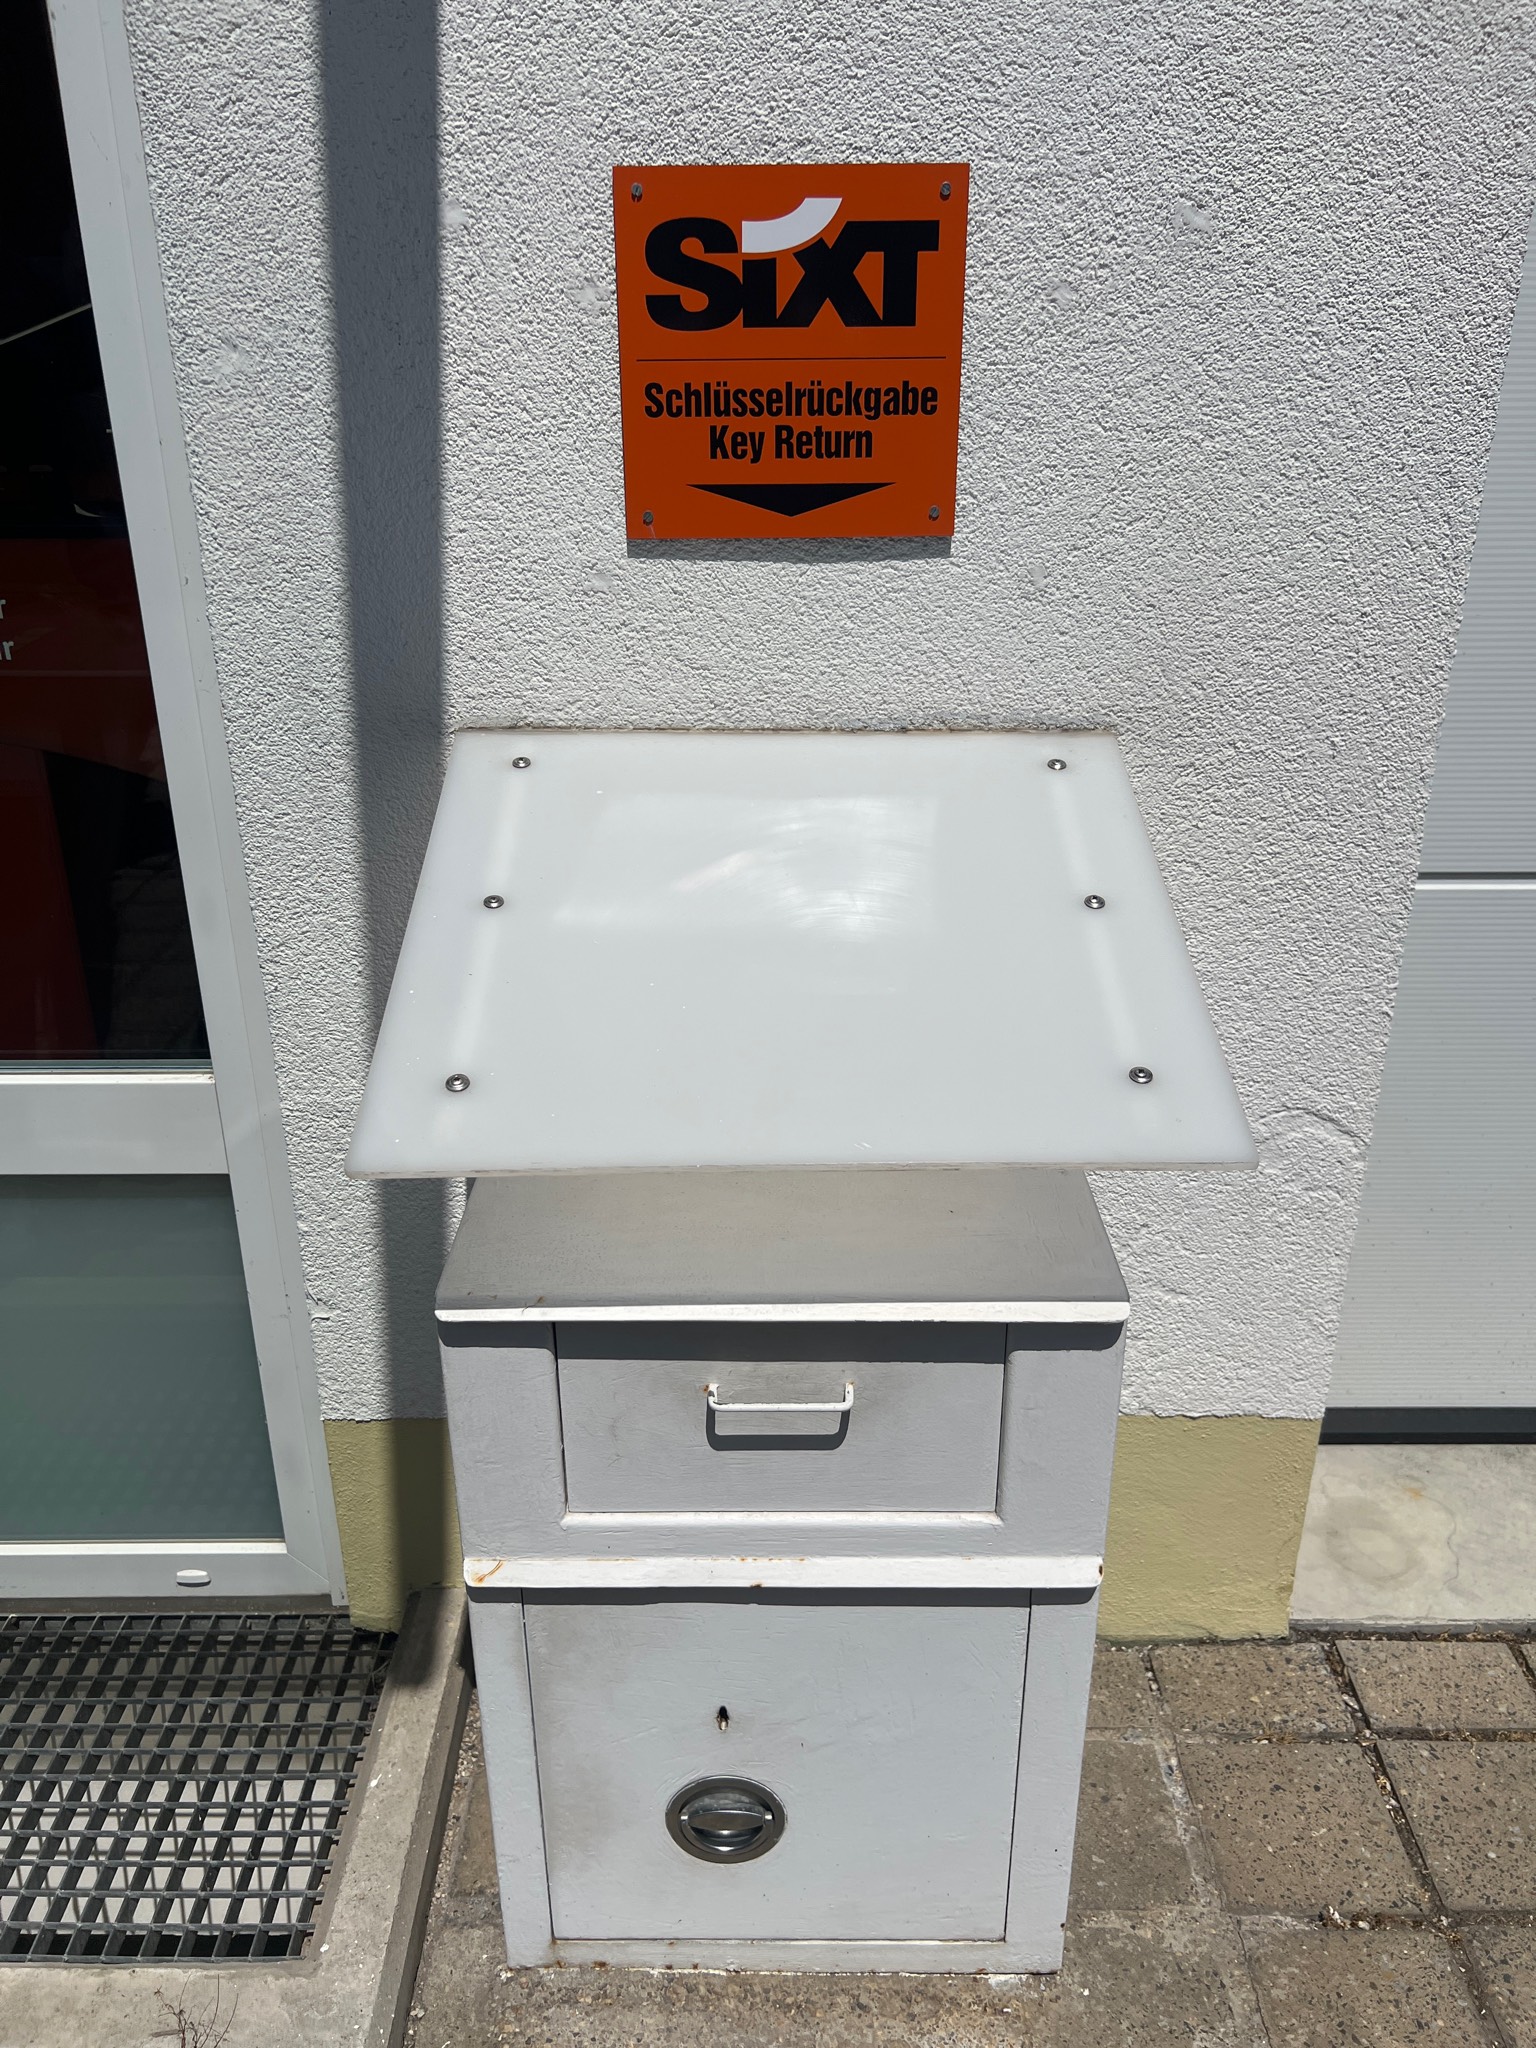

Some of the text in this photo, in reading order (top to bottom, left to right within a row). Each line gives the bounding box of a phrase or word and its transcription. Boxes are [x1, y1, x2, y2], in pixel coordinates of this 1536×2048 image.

[644, 380, 938, 421] Schlüsselrückgabe
[709, 425, 873, 464] Key Return
